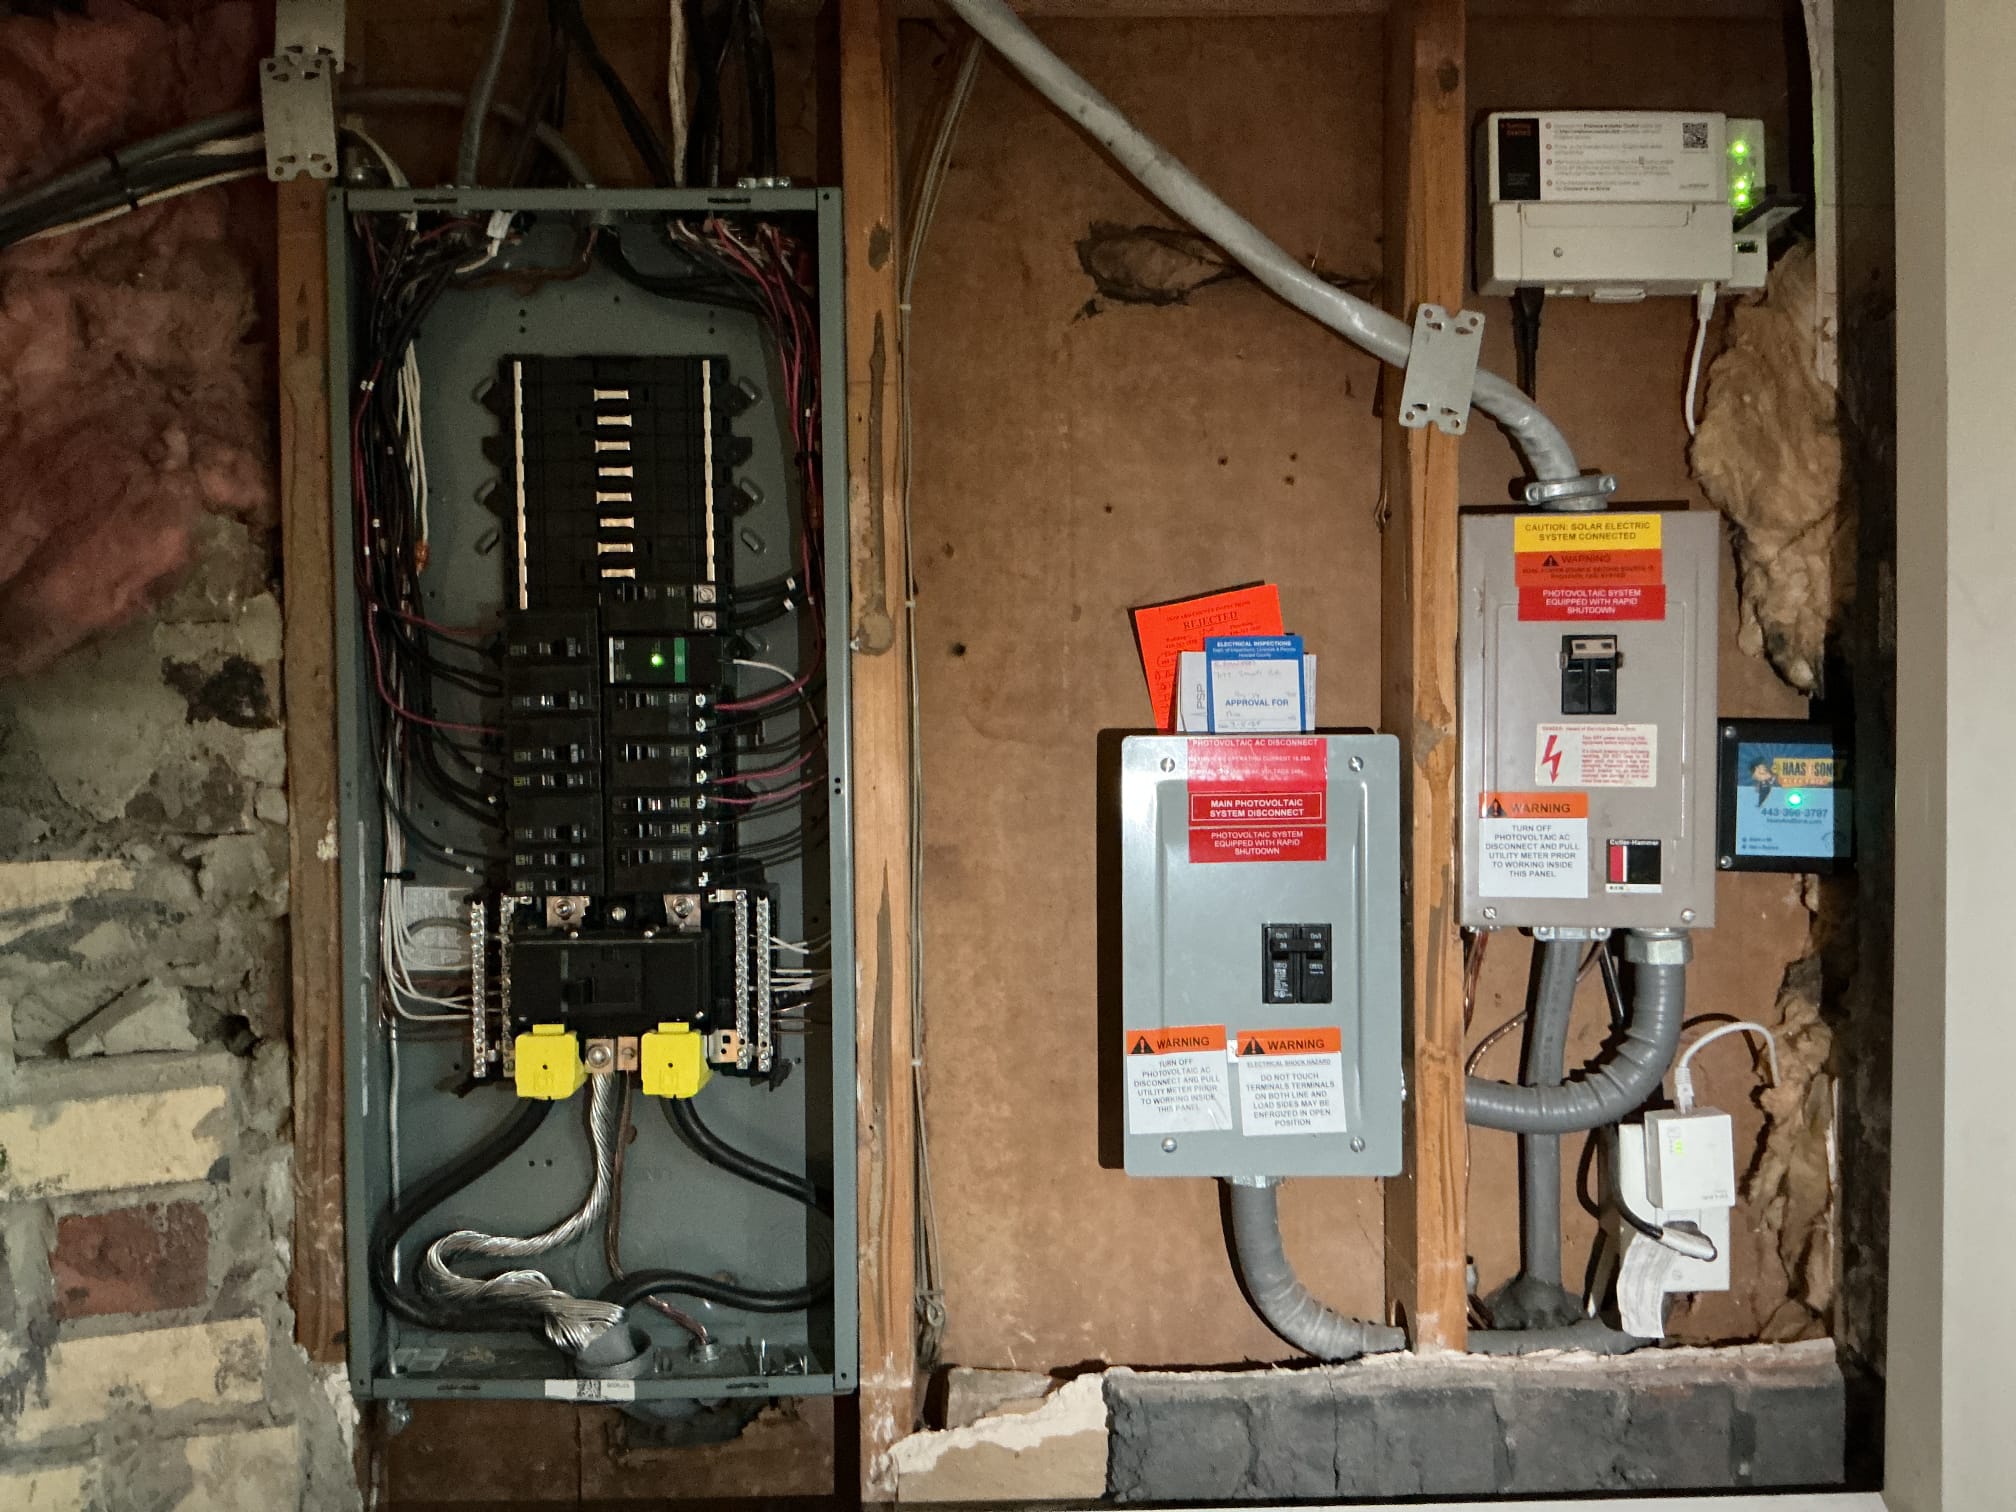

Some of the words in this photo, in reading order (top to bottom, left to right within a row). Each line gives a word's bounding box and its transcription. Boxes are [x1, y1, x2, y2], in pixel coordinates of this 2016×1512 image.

[1525, 524, 1567, 532] CAUTION:
[1571, 523, 1602, 531] SOLAR
[1605, 522, 1650, 530] ELECTRIC
[1539, 533, 1576, 541] SYSTEM
[1578, 532, 1636, 540] CONNECTED
[1568, 606, 1616, 614] SHUTDOWN
[1184, 611, 1238, 629] REJECTED
[1782, 762, 1806, 776] HAAS
[1235, 798, 1303, 806] PHOTOVOLTAIC
[1210, 810, 1245, 818] SYSTEM
[1248, 808, 1304, 816] DISCONNECT
[1511, 803, 1571, 814] WARNING
[1528, 870, 1556, 878] PANEL
[1157, 1036, 1210, 1050] WARNING
[1267, 1039, 1325, 1050] WARNING
[1247, 1060, 1283, 1068] ELECTRICAL
[1142, 1068, 1199, 1077] PHOTOVOLTAIC
[1261, 1073, 1272, 1081] DO
[1273, 1073, 1290, 1081] NOT
[1292, 1072, 1319, 1080] TOUCH
[1134, 1077, 1180, 1087] DISCONNECT
[1201, 1075, 1220, 1083] PULL
[1137, 1088, 1164, 1096] UTILITY
[1166, 1085, 1192, 1094] METER
[1246, 1082, 1289, 1092] TERMINALS
[1292, 1081, 1335, 1090] TERMINALS
[1153, 1095, 1189, 1104] WORKING
[1191, 1093, 1216, 1101] INSIDE
[1253, 1102, 1275, 1110] LOAD
[1276, 1101, 1299, 1109] SIDES
[1254, 1110, 1298, 1119] ENERGIZED
[1275, 1119, 1311, 1127] POSITION
